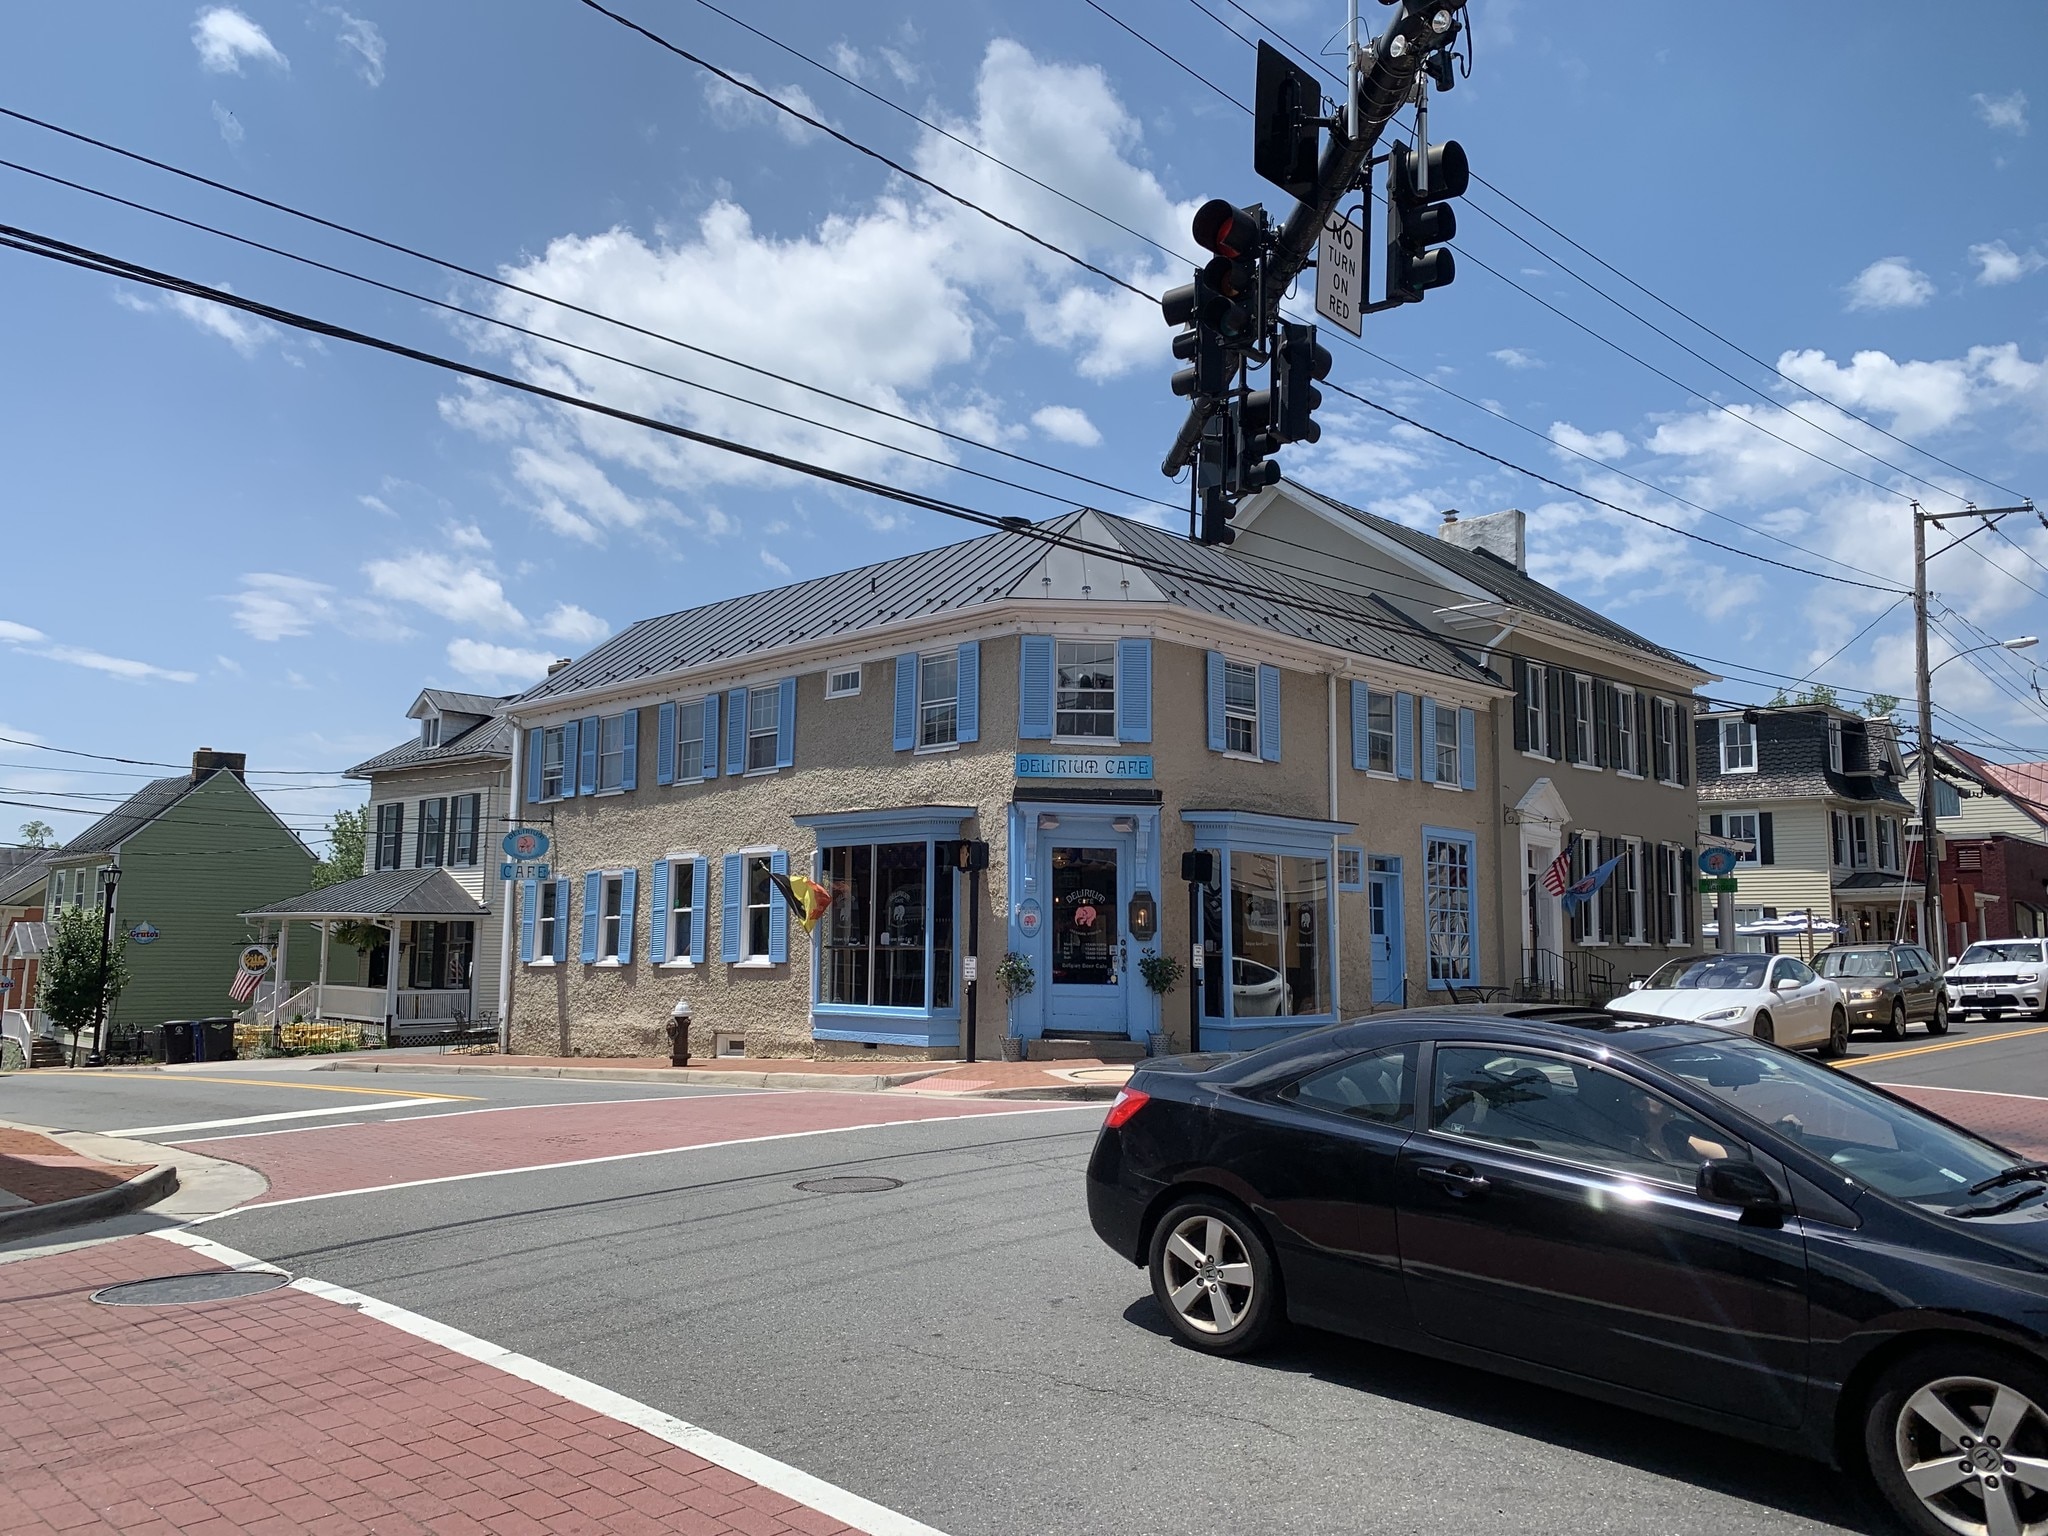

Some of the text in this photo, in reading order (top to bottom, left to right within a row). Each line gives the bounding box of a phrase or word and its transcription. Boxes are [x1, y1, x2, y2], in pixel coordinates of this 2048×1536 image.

[1332, 220, 1353, 250] NO
[1328, 245, 1356, 277] TURN
[1333, 273, 1348, 296] ON
[1329, 295, 1350, 319] RED
[1020, 759, 1149, 775] DELIRIUM CAFE
[507, 829, 545, 840] DELIRIUM
[503, 866, 546, 878] CAFE
[1065, 889, 1106, 904] DELIRIUM
[130, 930, 159, 938] Gruto's
